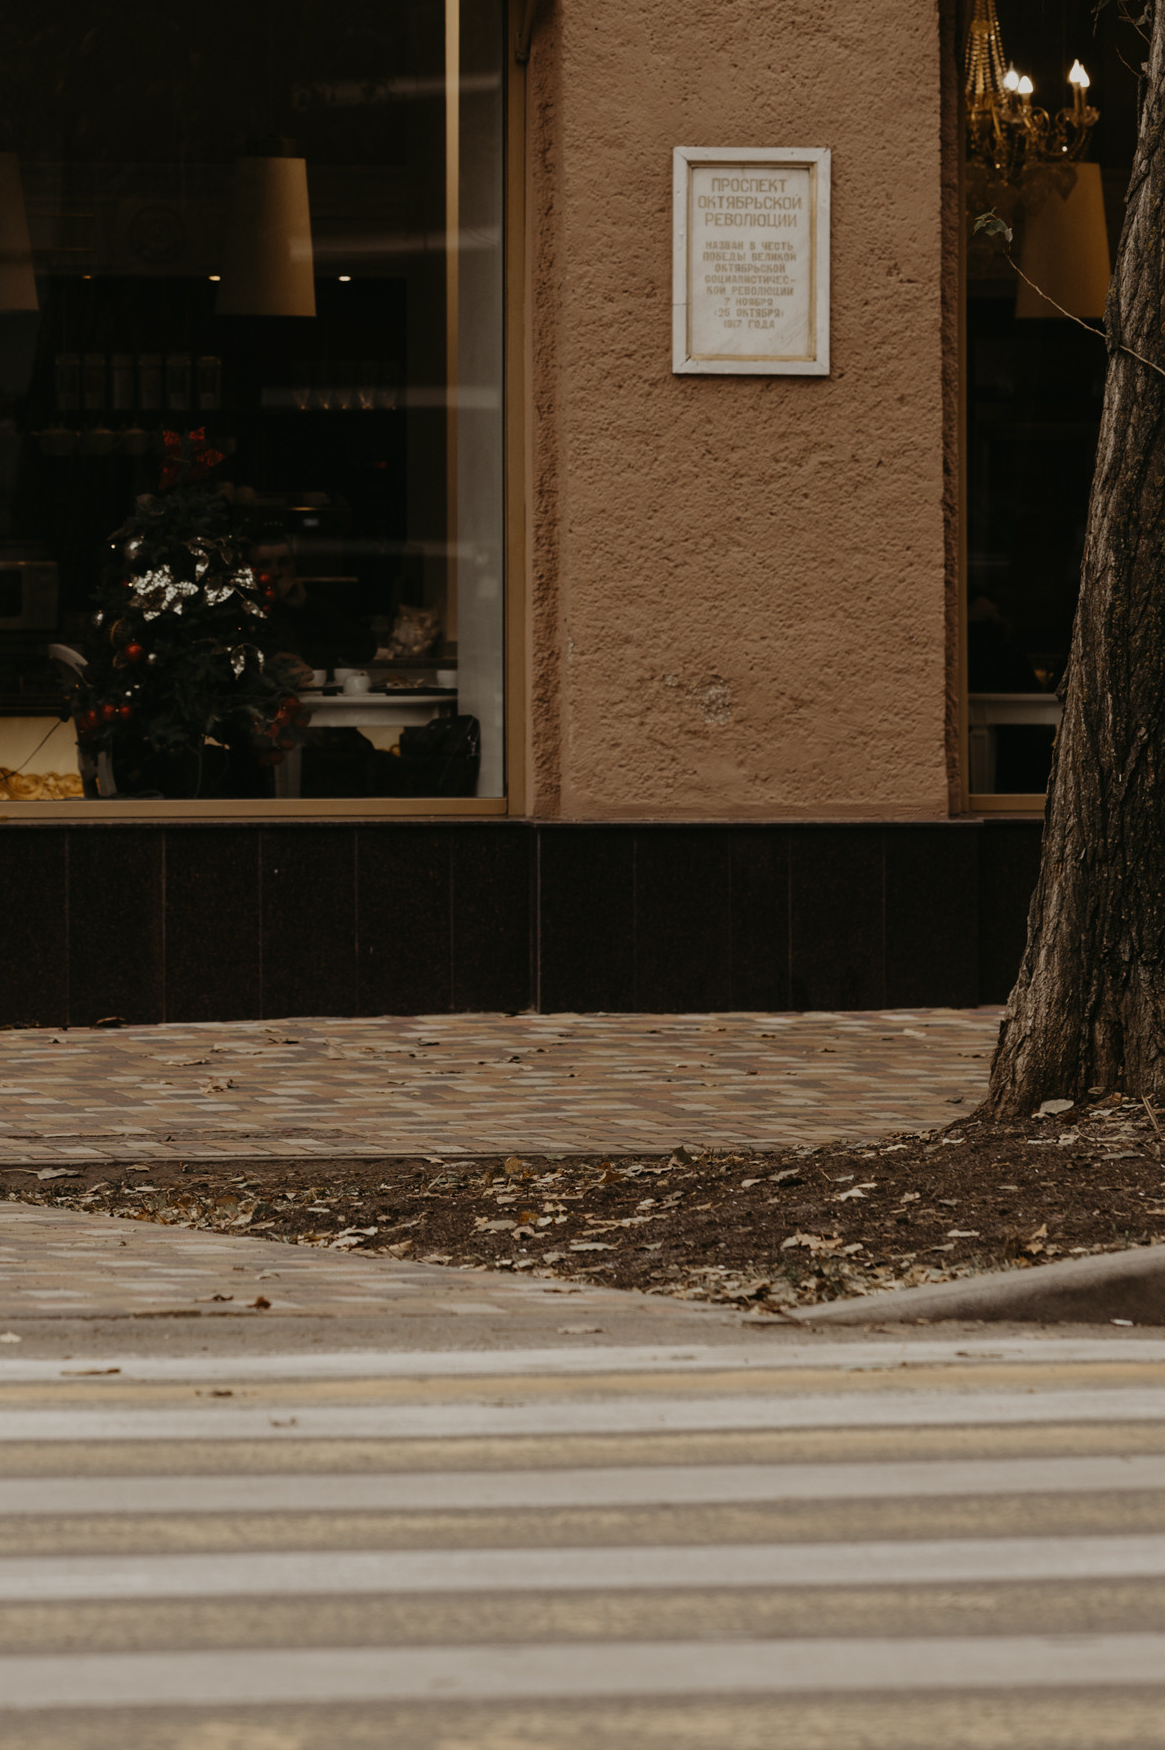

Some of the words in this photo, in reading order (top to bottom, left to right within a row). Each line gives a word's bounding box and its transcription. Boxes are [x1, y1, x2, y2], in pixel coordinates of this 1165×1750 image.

[711, 177, 788, 193] ПРОСПЕКТ
[697, 193, 803, 210] ОКТЯБРЬСКОЙ
[704, 212, 798, 228] РЕВОЛЮЦИИ
[705, 240, 744, 251] НАЗВАН
[749, 240, 756, 251] В
[761, 241, 794, 251] ЧЕСТЬ
[702, 251, 746, 262] ПОБЕДЫ
[731, 286, 794, 296] РЕВОЛЮЦИИ
[724, 297, 731, 307] 7
[735, 297, 774, 307] НОЯБРЯ
[723, 319, 742, 329] 1917
[747, 319, 775, 330] ГОДА
